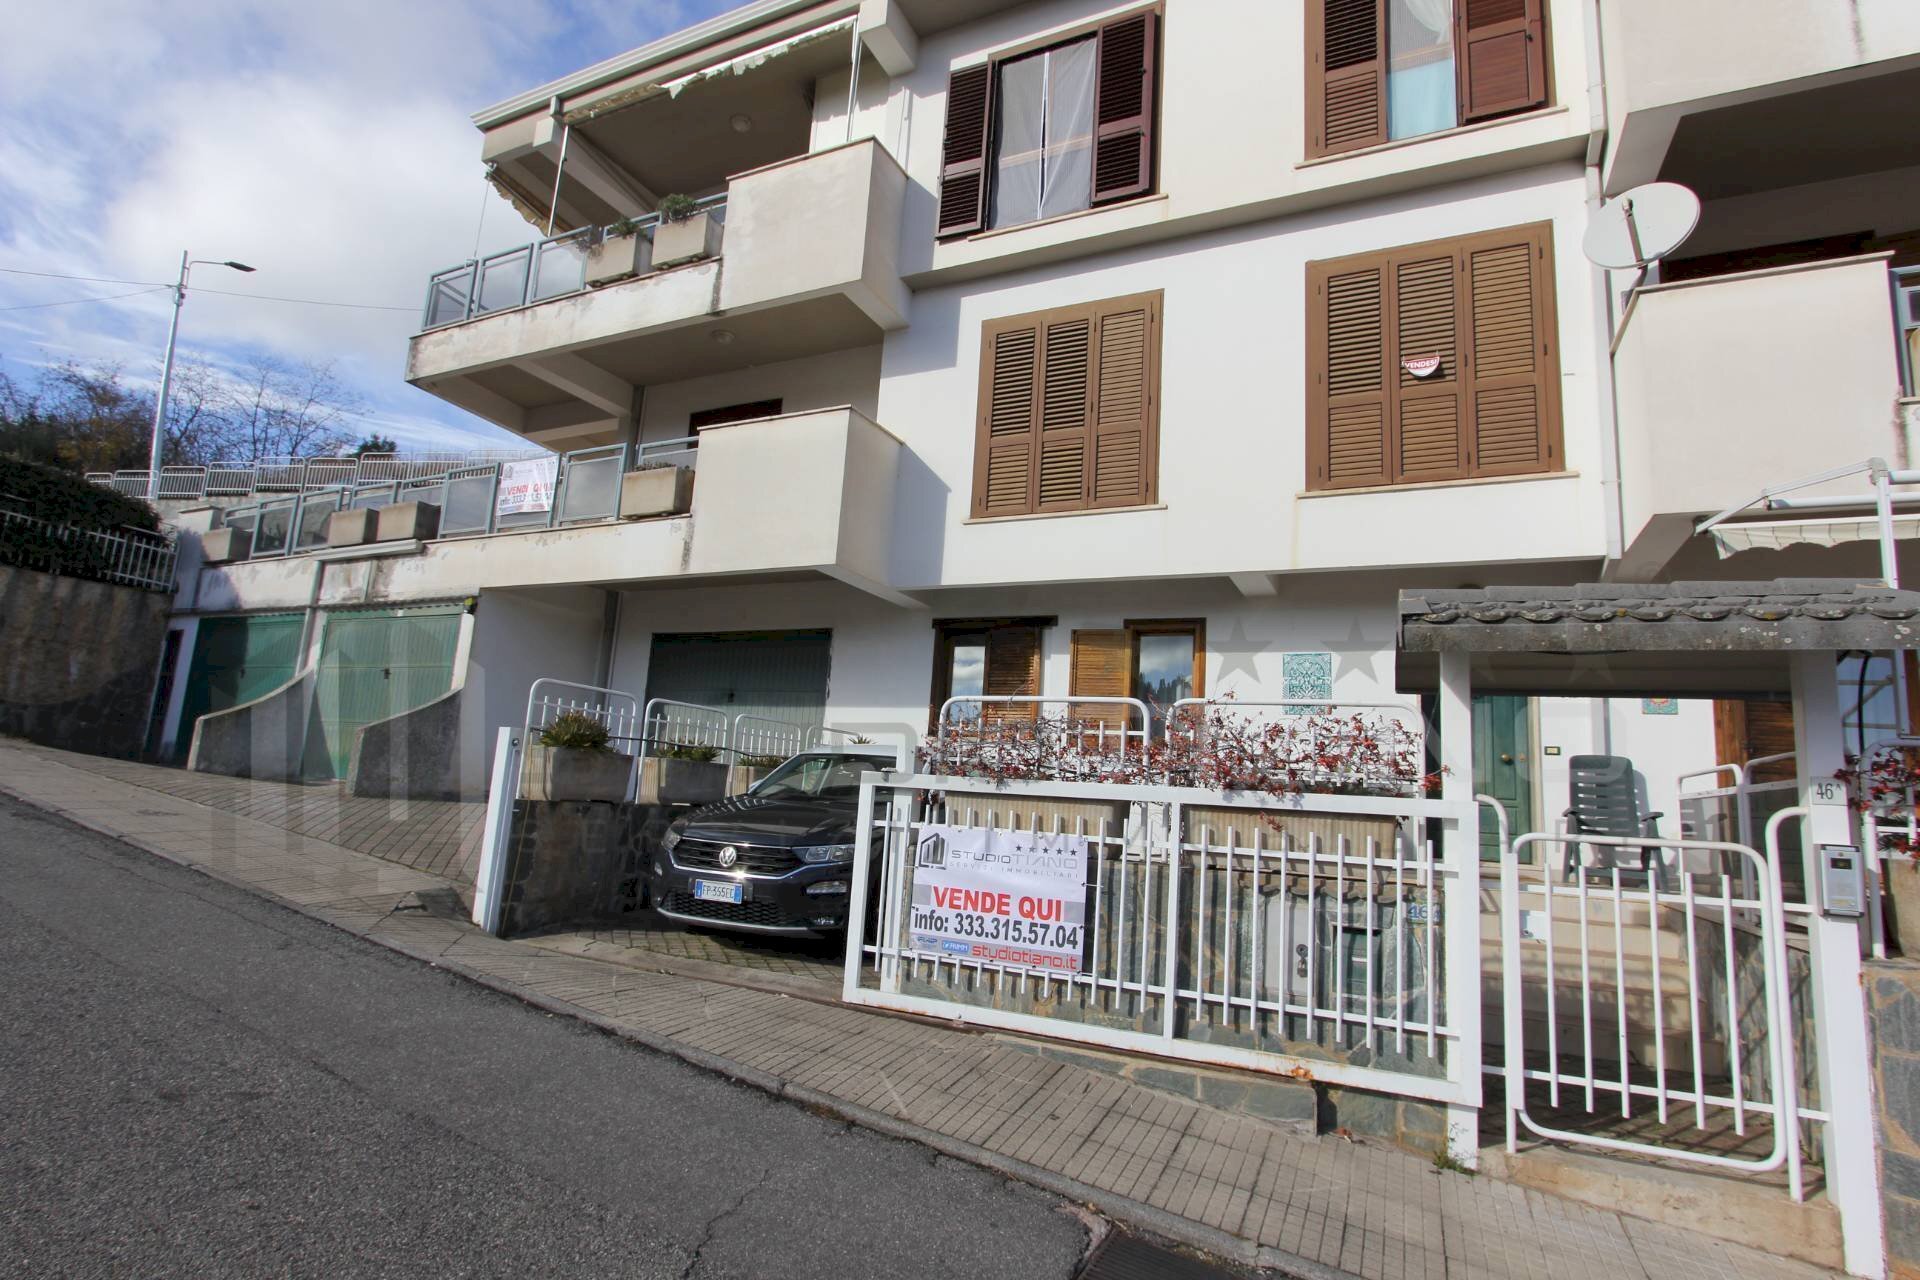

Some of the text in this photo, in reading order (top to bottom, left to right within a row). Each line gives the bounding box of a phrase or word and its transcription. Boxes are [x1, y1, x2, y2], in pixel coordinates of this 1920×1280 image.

[1405, 360, 1437, 368] VENDESI
[933, 885, 1062, 922] VENDE QUI
[914, 908, 1078, 949] info: 333.315.57.04
[972, 944, 1078, 970] studiotiano.it
